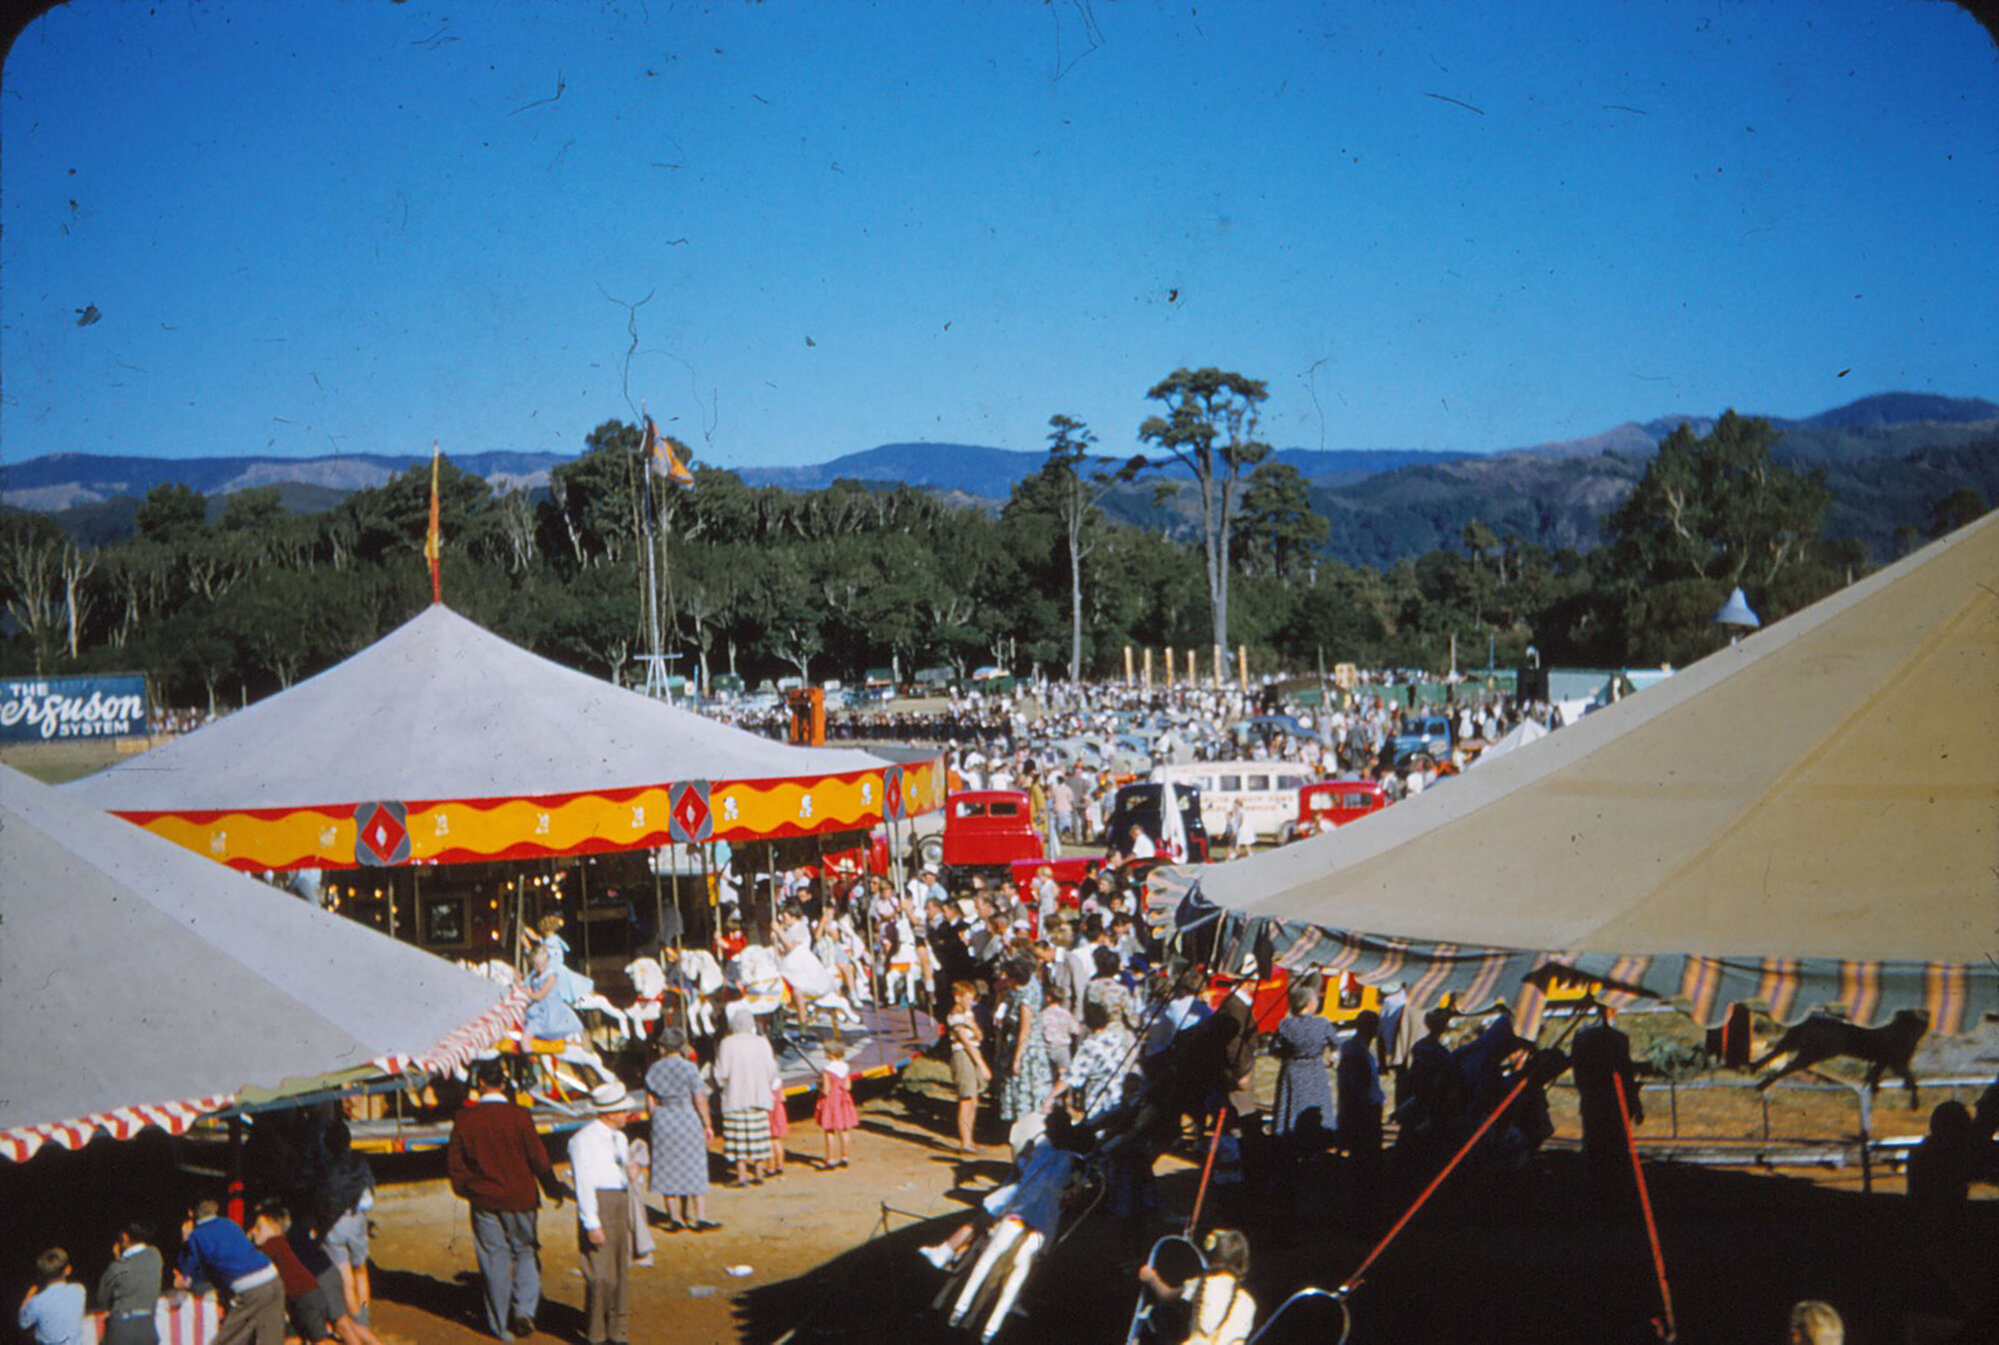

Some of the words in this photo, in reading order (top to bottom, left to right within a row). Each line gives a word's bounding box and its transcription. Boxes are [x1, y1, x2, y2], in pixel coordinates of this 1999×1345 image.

[10, 682, 48, 697] THE
[0, 691, 144, 739] erguson
[59, 720, 130, 736] SYSTEM
